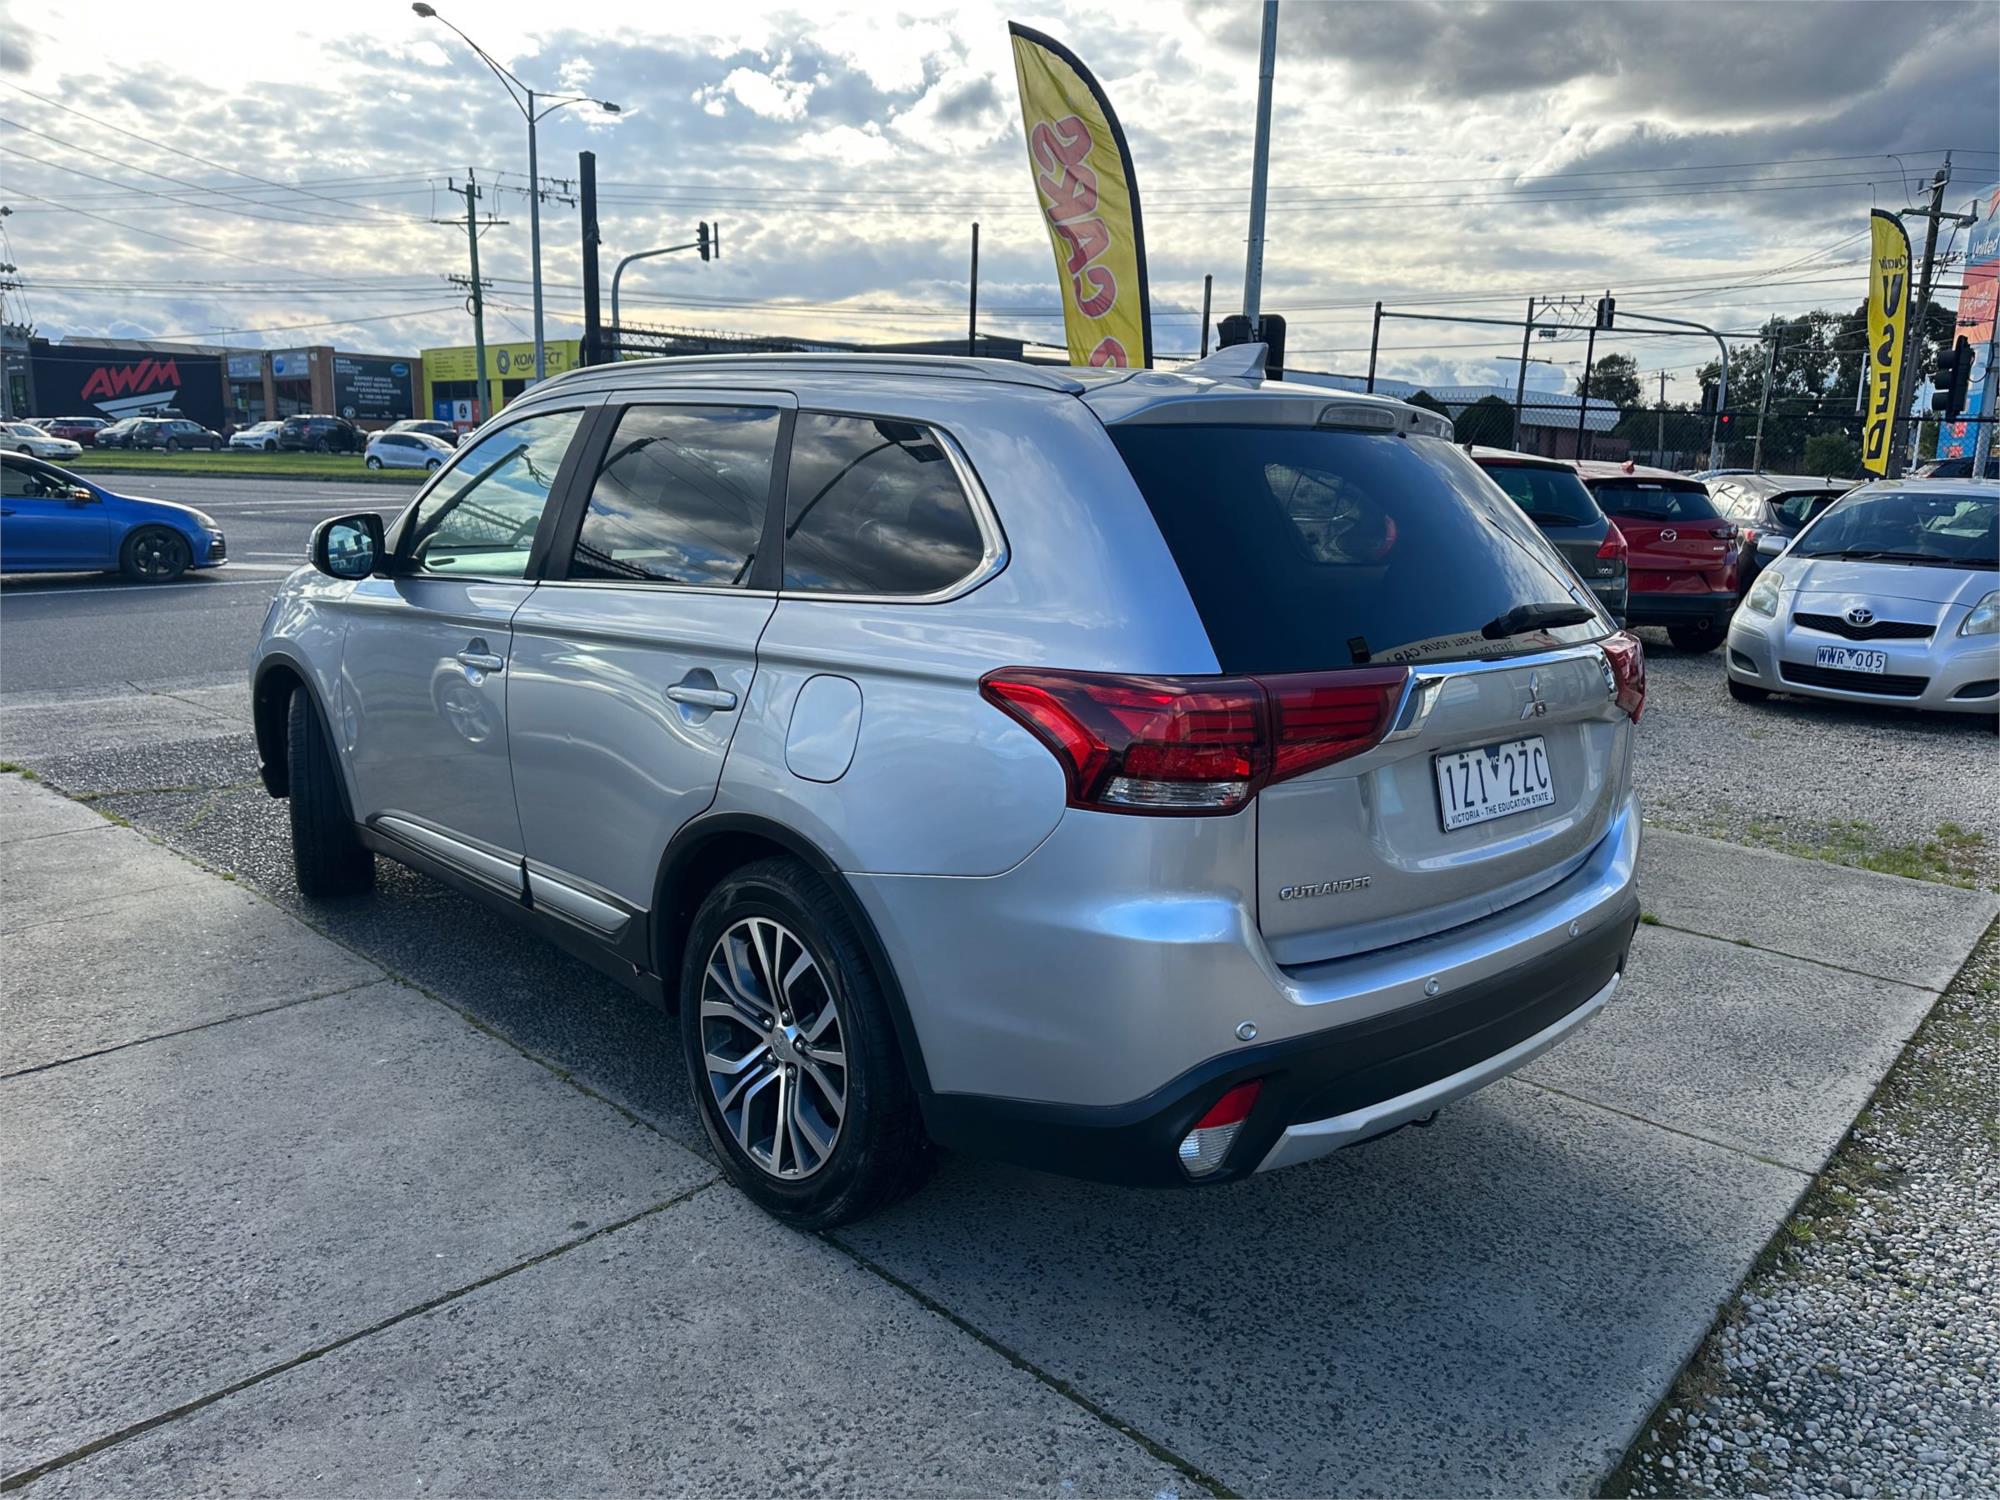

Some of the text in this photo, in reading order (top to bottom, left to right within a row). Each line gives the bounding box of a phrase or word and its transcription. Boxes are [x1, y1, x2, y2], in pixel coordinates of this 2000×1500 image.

[514, 352, 562, 367] KONECT
[81, 357, 181, 400] AWM
[1818, 648, 1883, 669] WWR 005
[1504, 747, 1547, 797] 2ZC
[1450, 809, 1480, 824] VICTORIA
[1485, 804, 1498, 816] THE
[1498, 796, 1531, 813] EDUCATION
[1531, 791, 1549, 804] STATE
[1280, 876, 1371, 900] OUTLANDER
